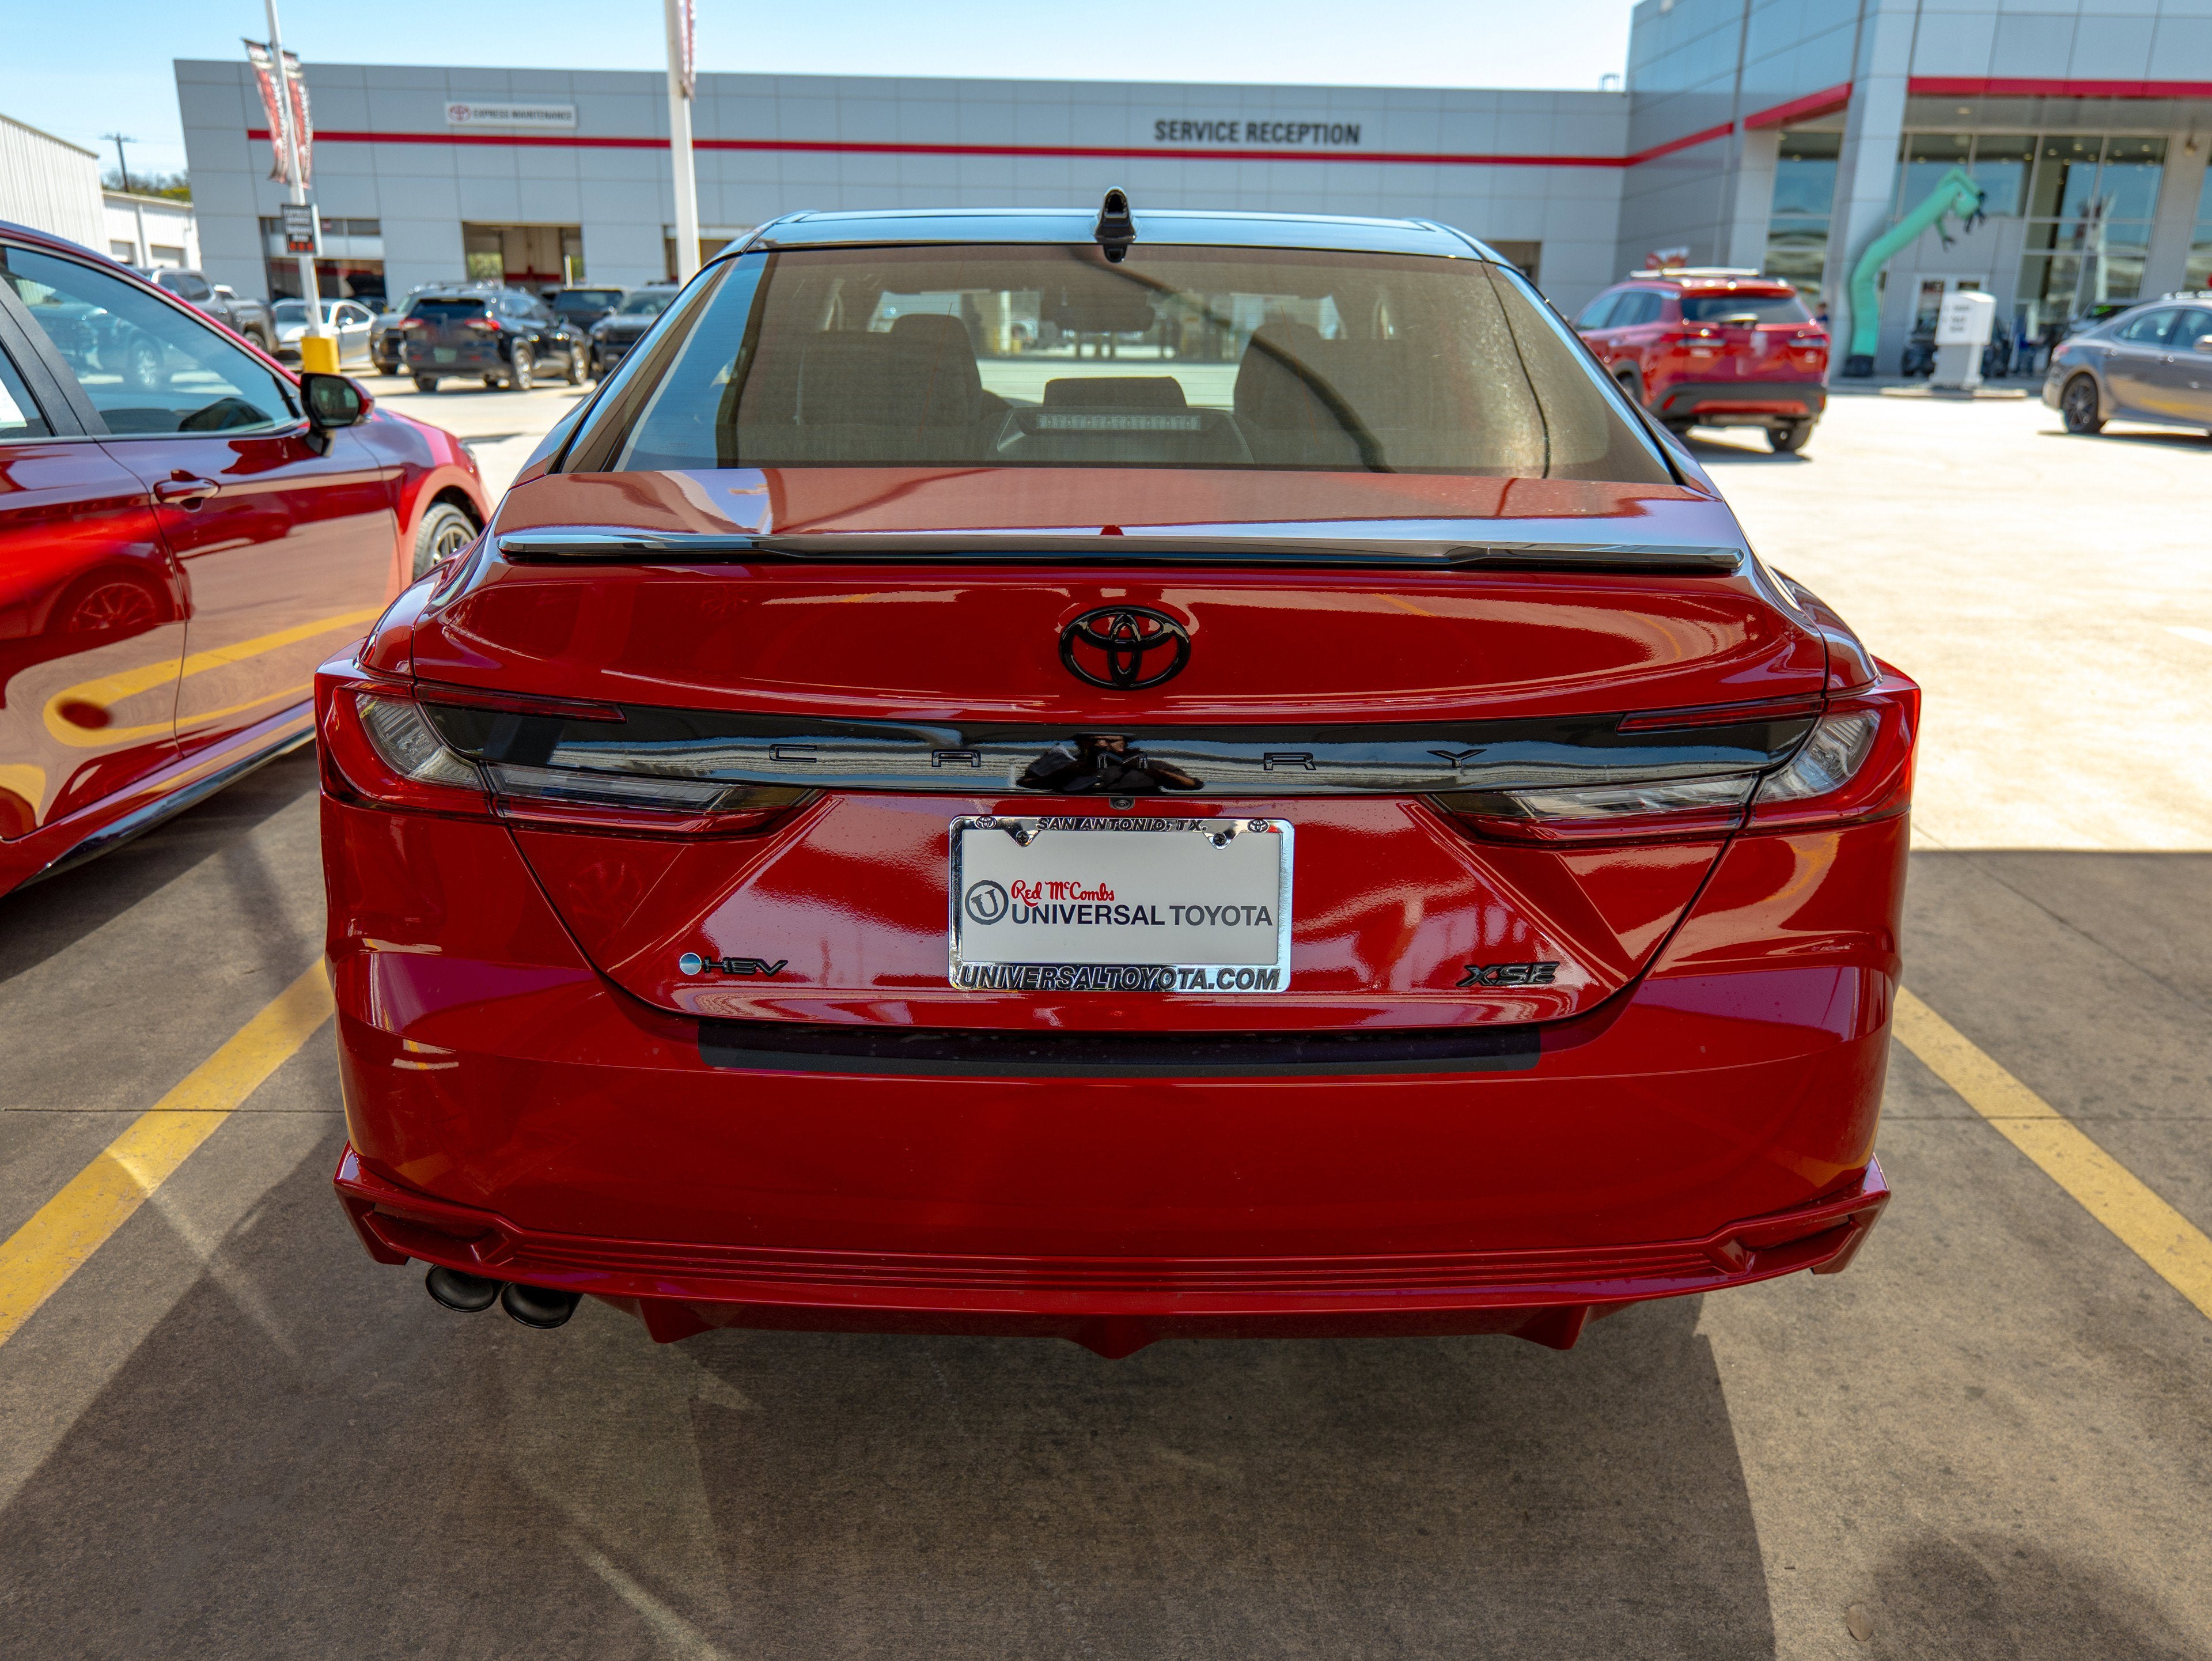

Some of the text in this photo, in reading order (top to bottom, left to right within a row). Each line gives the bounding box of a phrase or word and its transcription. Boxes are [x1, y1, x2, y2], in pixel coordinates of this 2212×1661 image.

[1155, 120, 1360, 145] SERVICE RECEPTION
[1036, 817, 1077, 831] SAN
[1011, 880, 1115, 907] Red McCombs
[1012, 903, 1273, 926] UNIVERSAL TOYOTA
[703, 956, 789, 977] HEV
[958, 964, 1281, 990] UNIVERSALTOYOTA.COM
[1456, 961, 1560, 987] XSE
